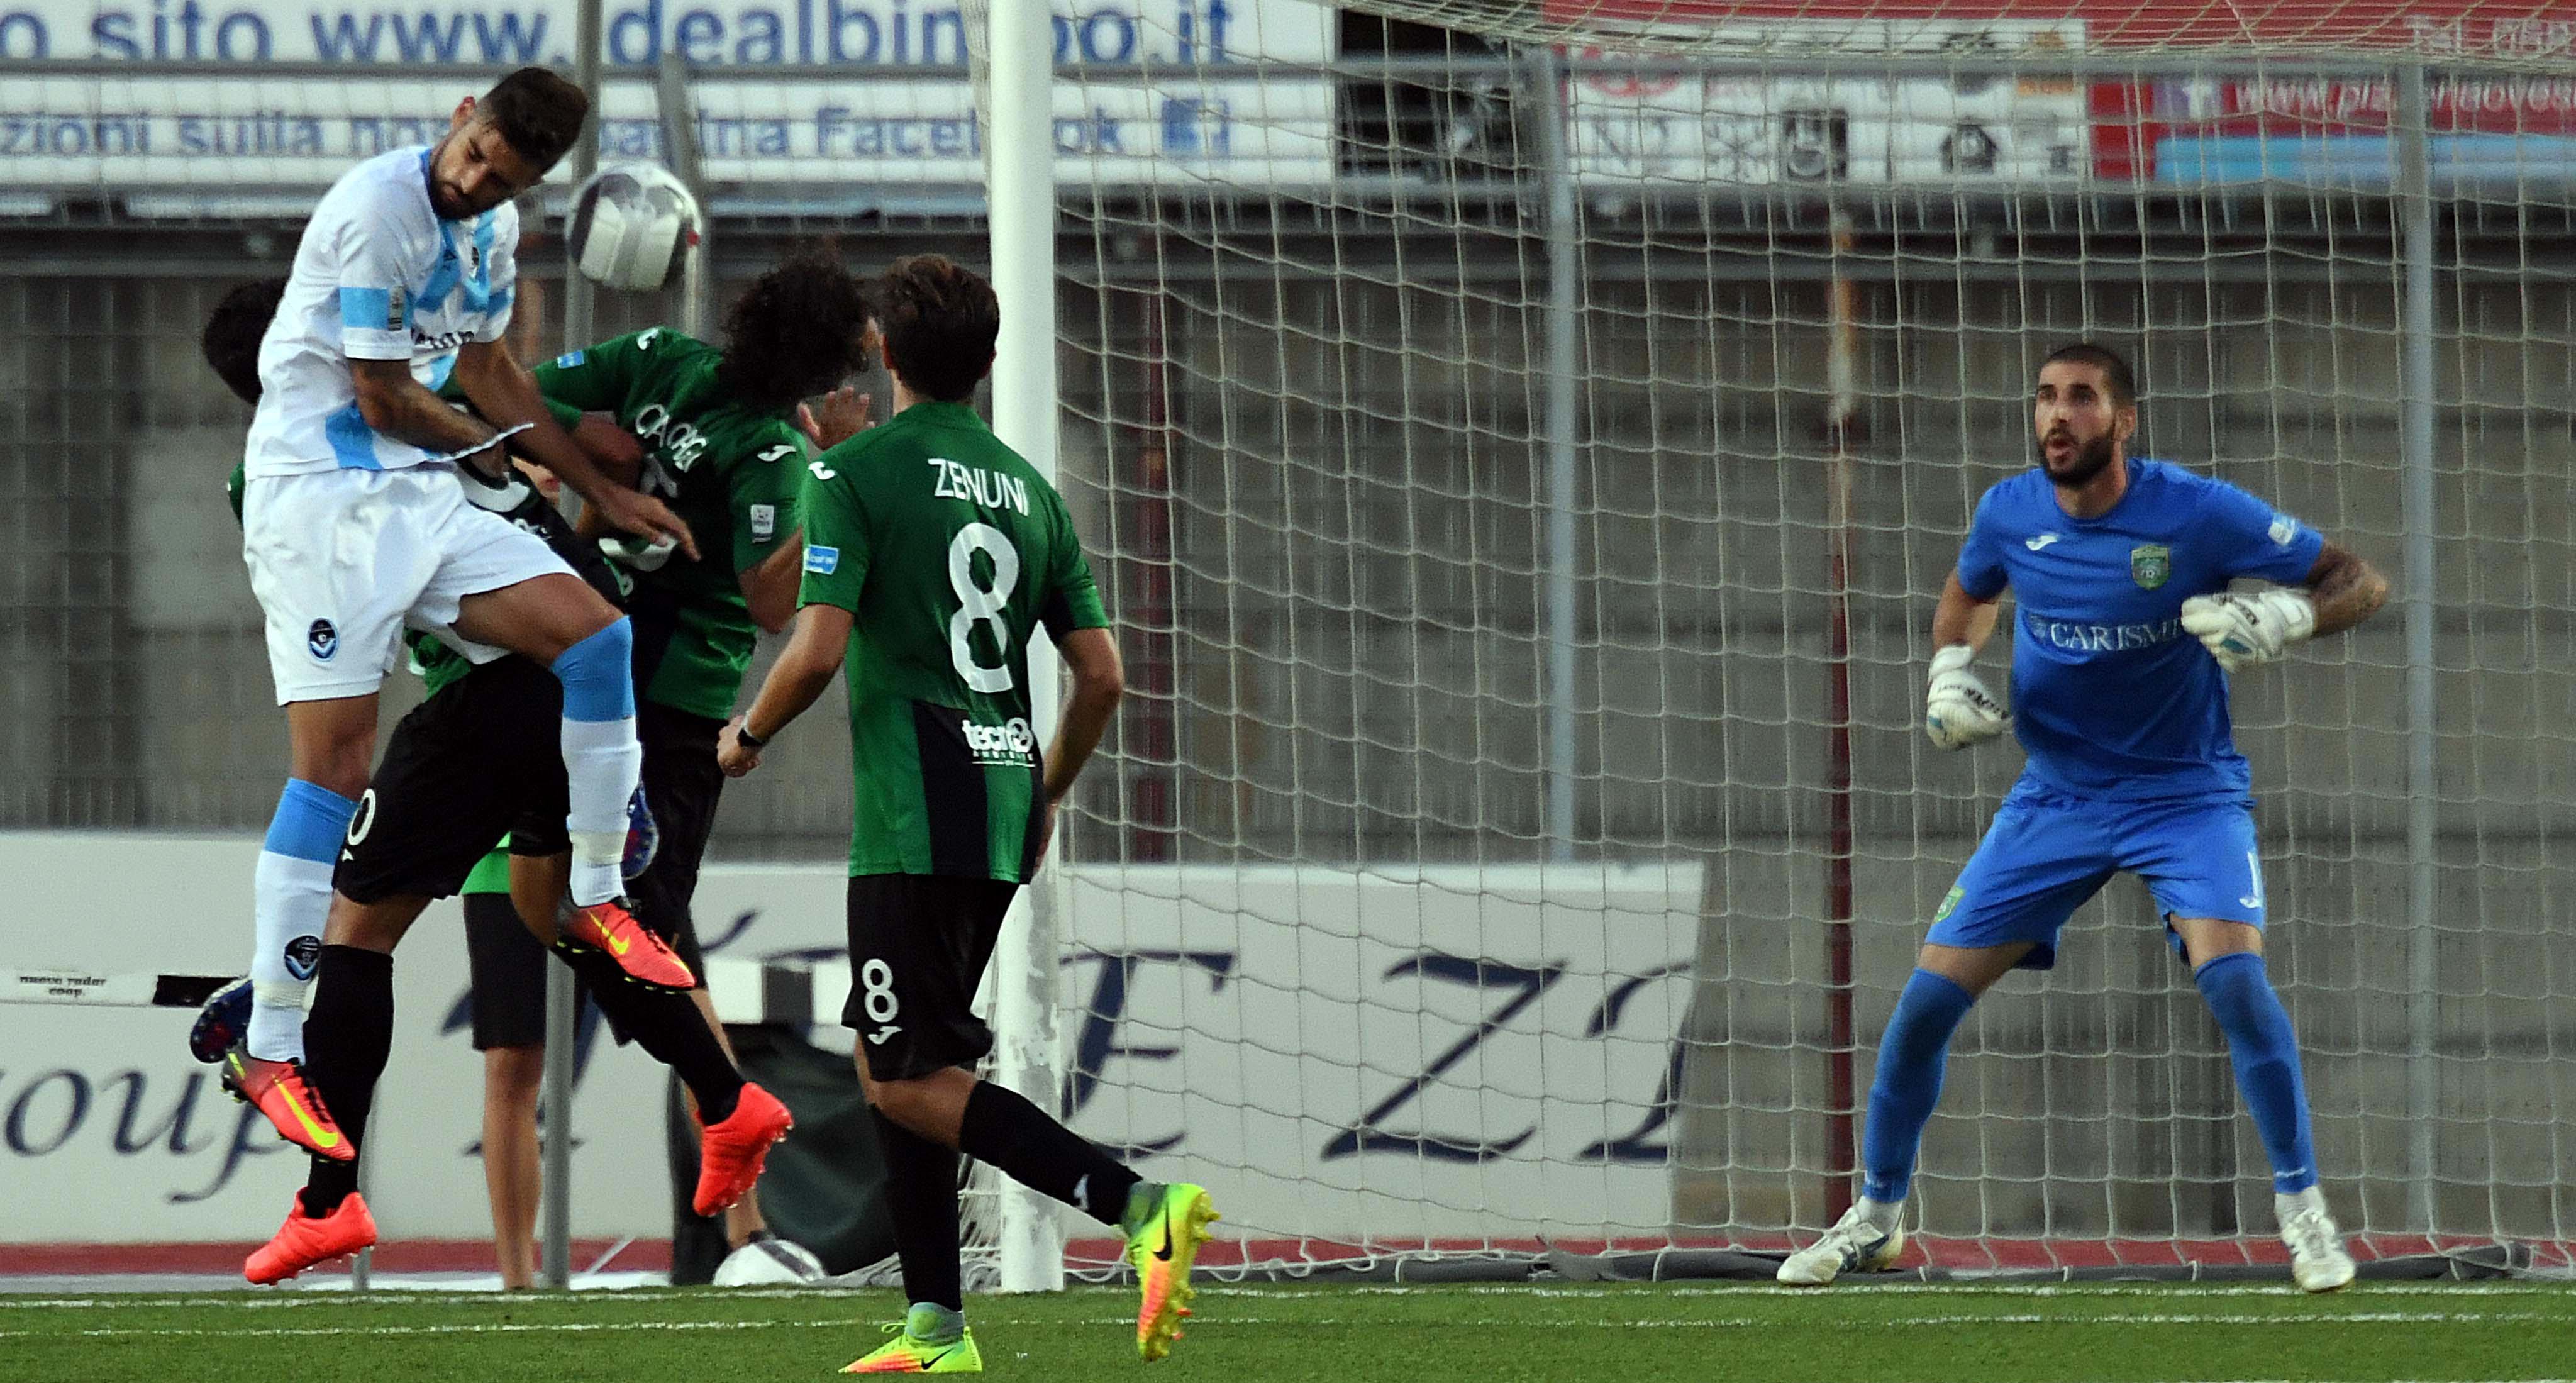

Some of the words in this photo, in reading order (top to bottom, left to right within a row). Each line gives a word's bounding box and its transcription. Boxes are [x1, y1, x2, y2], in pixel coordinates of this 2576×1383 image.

[92, 0, 272, 62] sito
[179, 111, 320, 155] sulla
[928, 458, 1030, 516] ZENUNI
[948, 522, 1019, 692] 8
[862, 958, 899, 1023] 8
